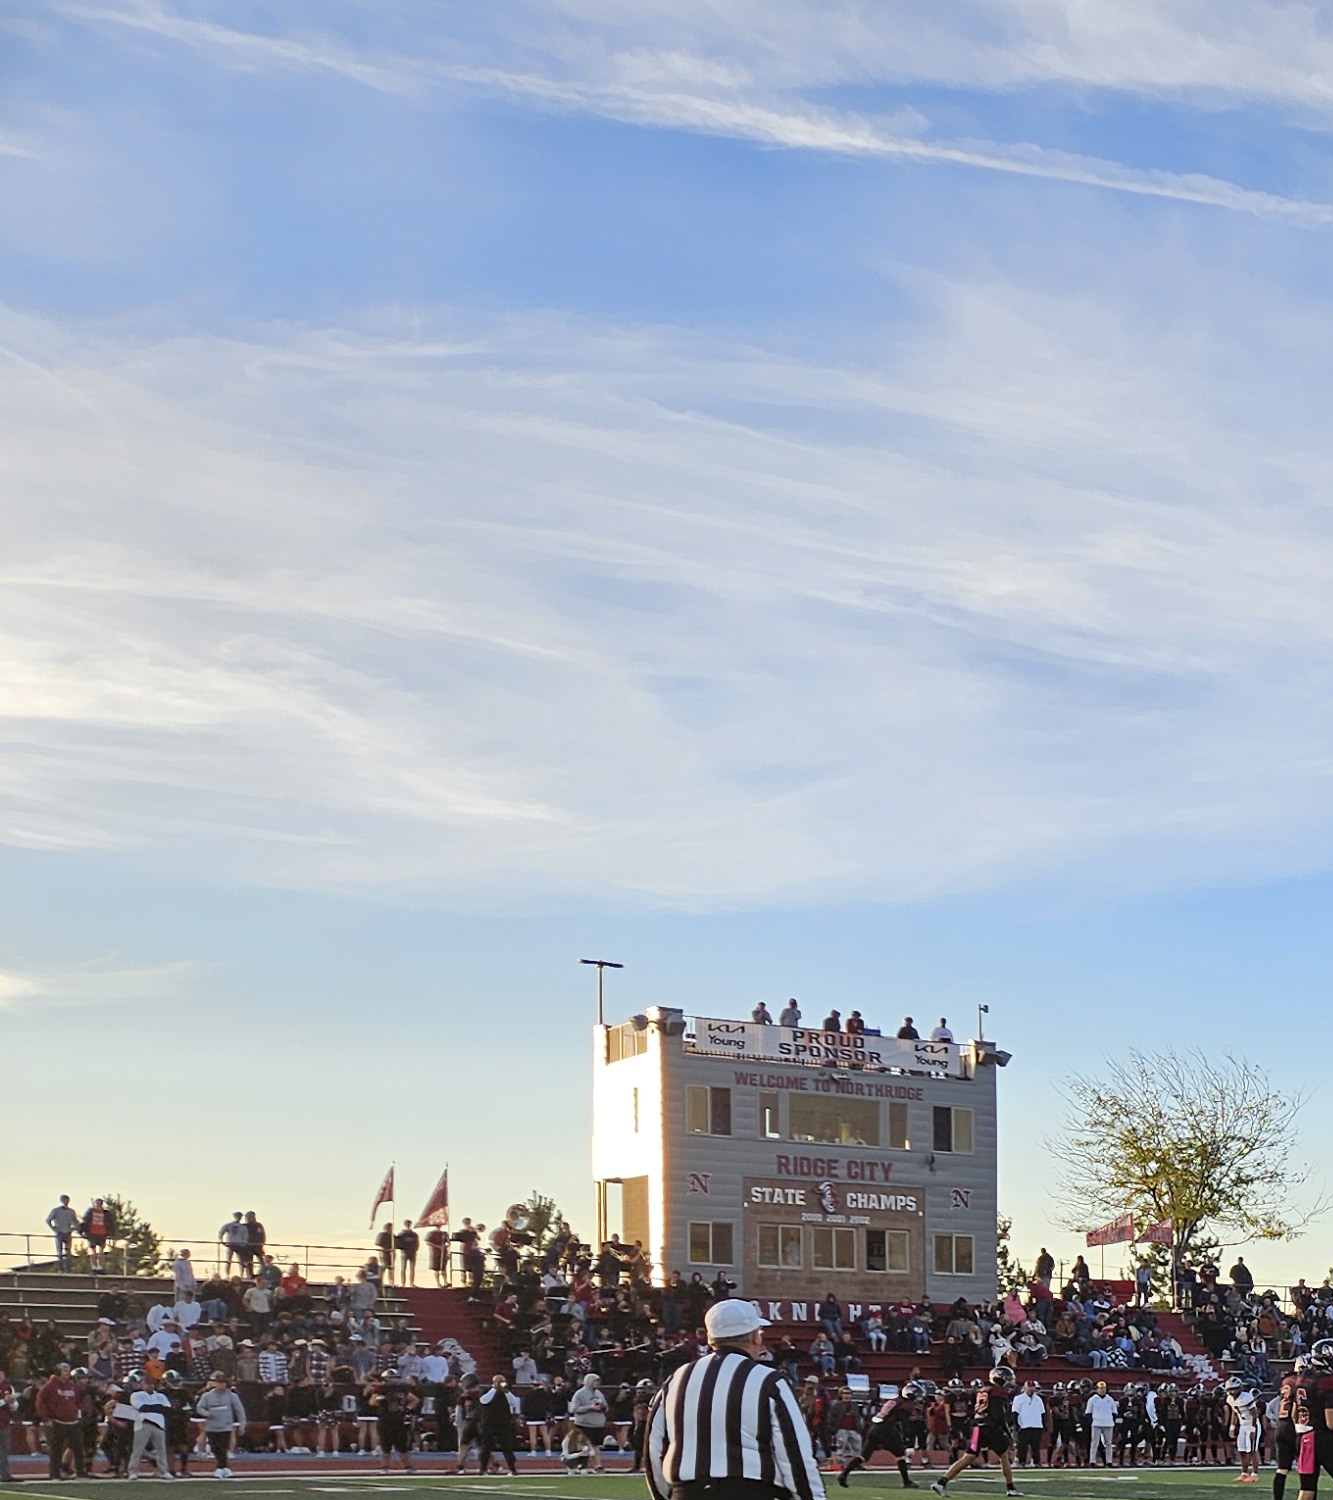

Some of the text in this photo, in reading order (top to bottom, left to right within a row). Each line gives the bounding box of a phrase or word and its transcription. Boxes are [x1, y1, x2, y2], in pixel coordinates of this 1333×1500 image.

[708, 1034, 745, 1050] Young
[792, 1030, 864, 1048] PROUD
[779, 1042, 881, 1064] SPONSOR
[914, 1055, 948, 1070] Young
[733, 1071, 924, 1100] WELCOME TO NORTHRIDGE
[776, 1154, 893, 1182] RIDGE CITY
[687, 1172, 711, 1194] N
[751, 1186, 917, 1212] STATE CHAMPS
[950, 1188, 972, 1210] N
